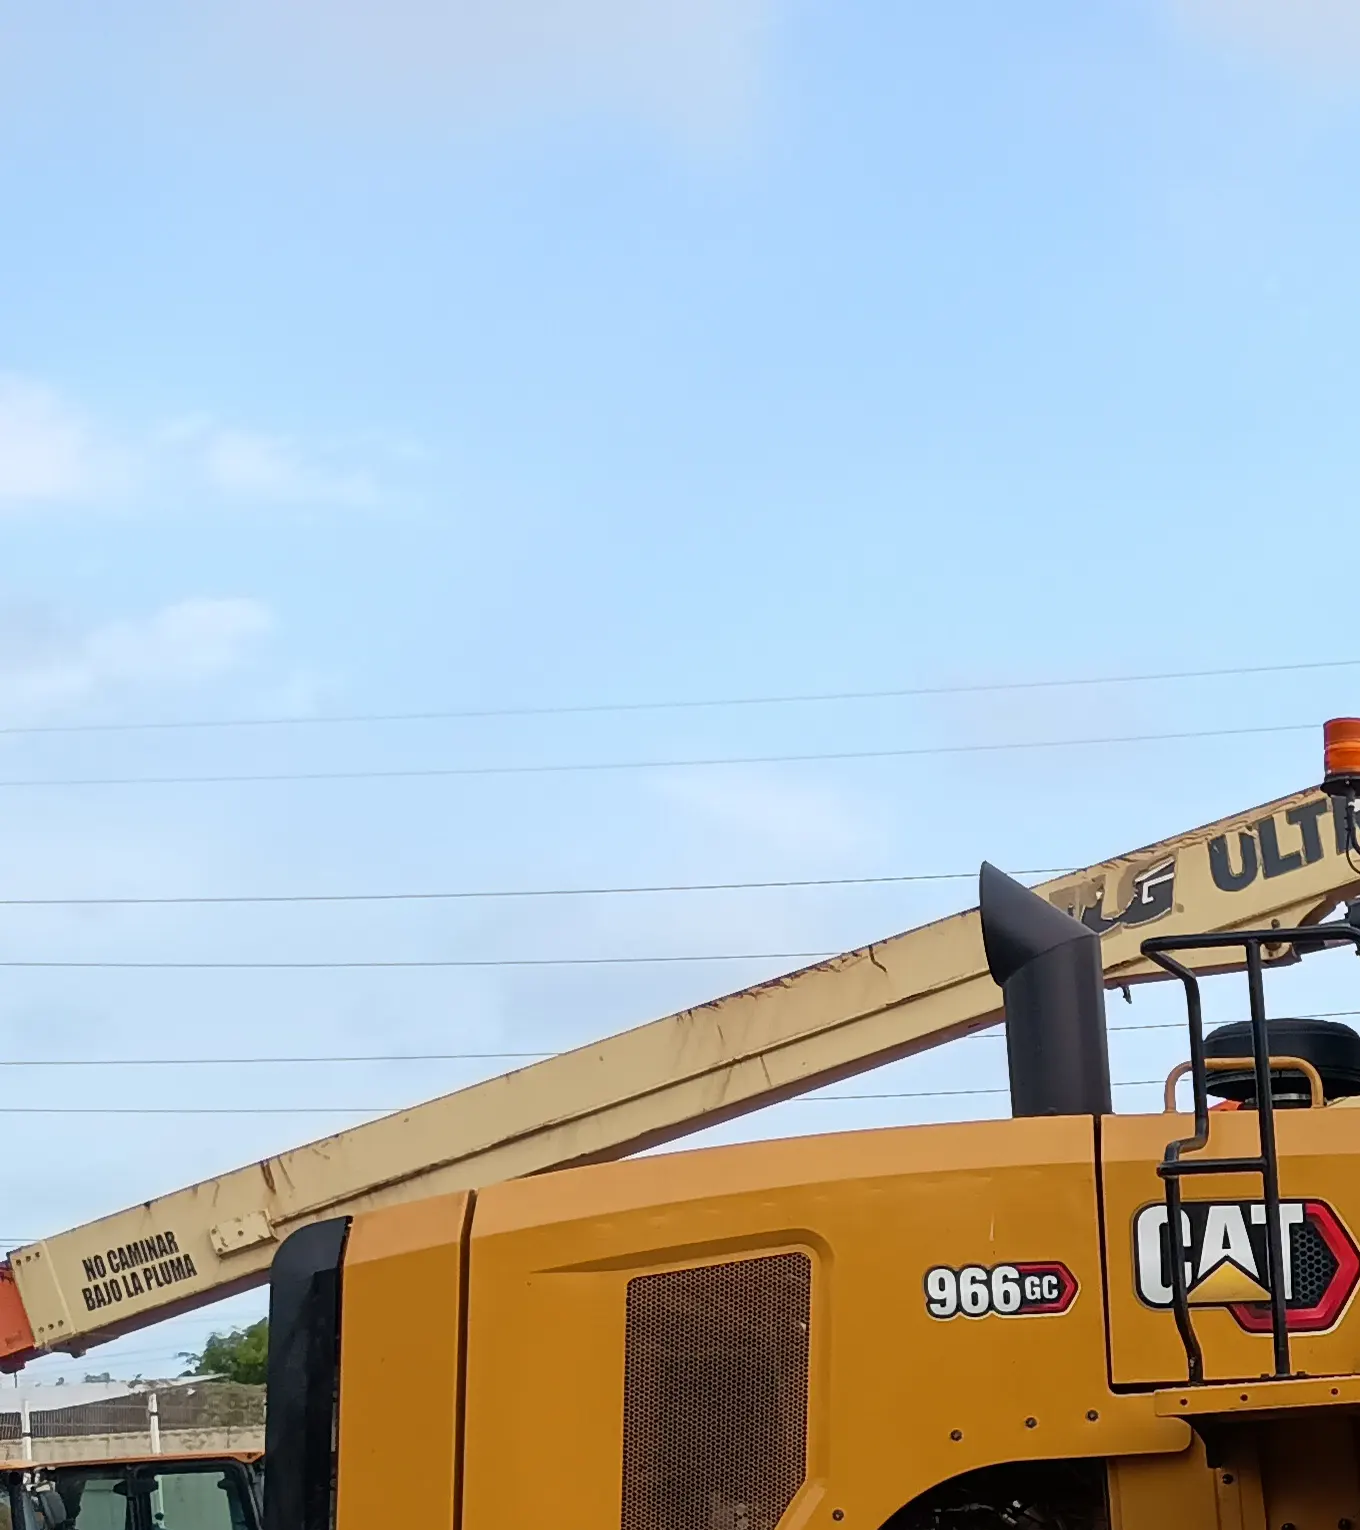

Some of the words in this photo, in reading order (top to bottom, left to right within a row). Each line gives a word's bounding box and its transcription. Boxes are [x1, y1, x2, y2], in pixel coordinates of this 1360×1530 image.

[82, 1254, 107, 1282] NO
[106, 1231, 180, 1274] CAMINAR
[1137, 1203, 1304, 1304] CAT
[81, 1278, 123, 1312] BAJO
[121, 1271, 145, 1298] LA
[142, 1253, 198, 1291] PLUMA
[927, 1265, 1021, 1316] 966
[1024, 1274, 1059, 1301] GC
